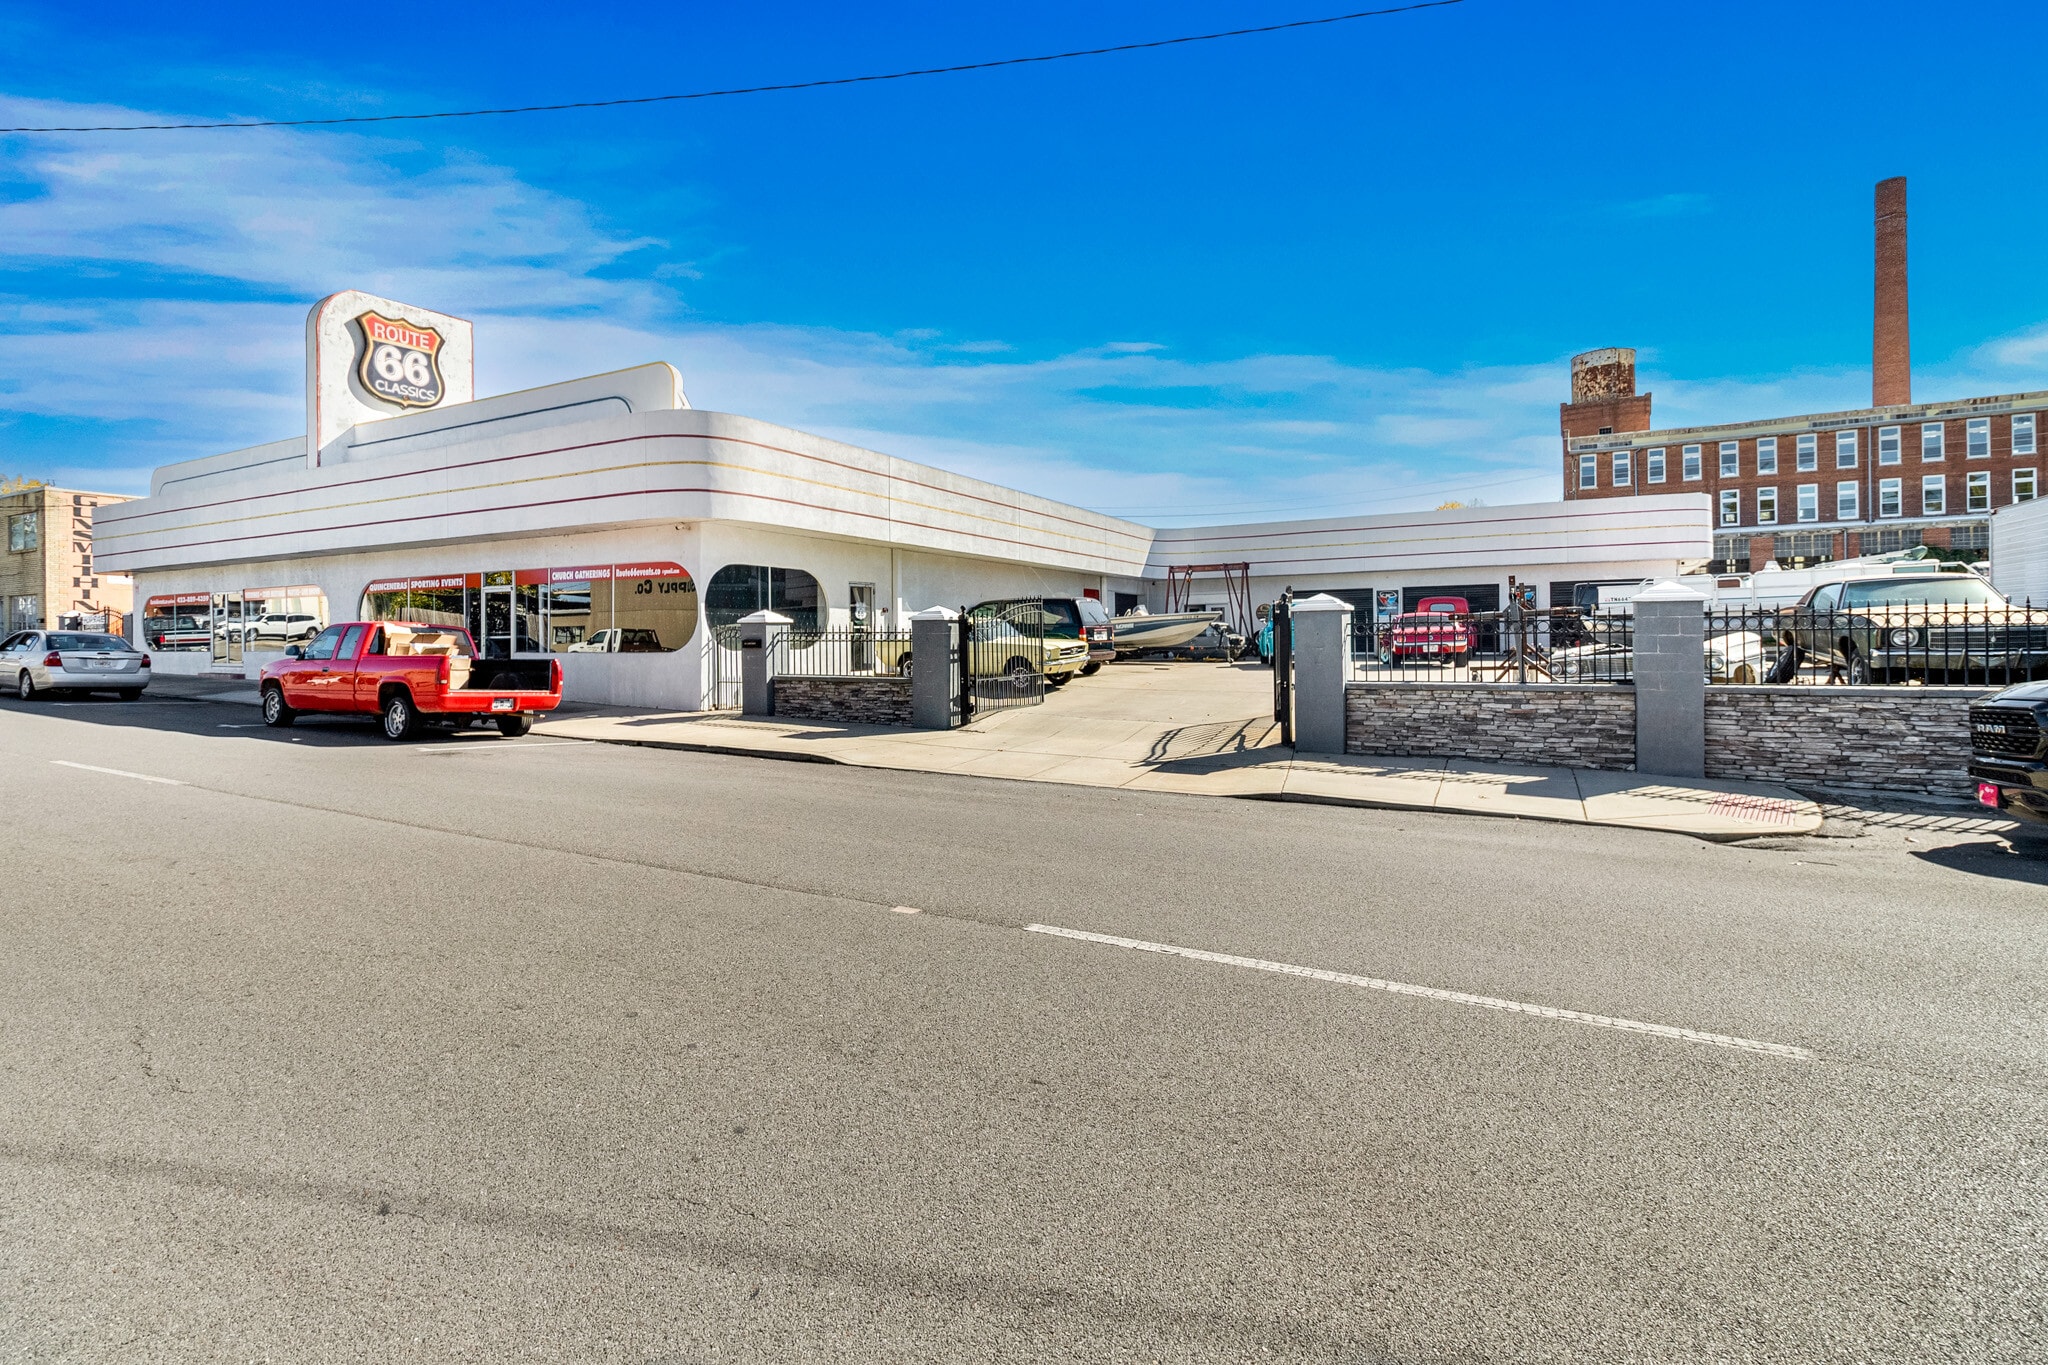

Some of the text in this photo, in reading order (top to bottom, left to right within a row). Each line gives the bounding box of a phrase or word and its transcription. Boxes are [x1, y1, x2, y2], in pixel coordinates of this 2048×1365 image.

[373, 322, 430, 349] ROUTE
[374, 345, 430, 387] 66
[375, 379, 435, 401] CLASSICS
[551, 569, 611, 581] CHURCH GATHERINGS
[369, 581, 408, 592] QUINCENERAS
[410, 577, 463, 589] SPORTING EVENTS
[1976, 724, 2006, 734] RAM
